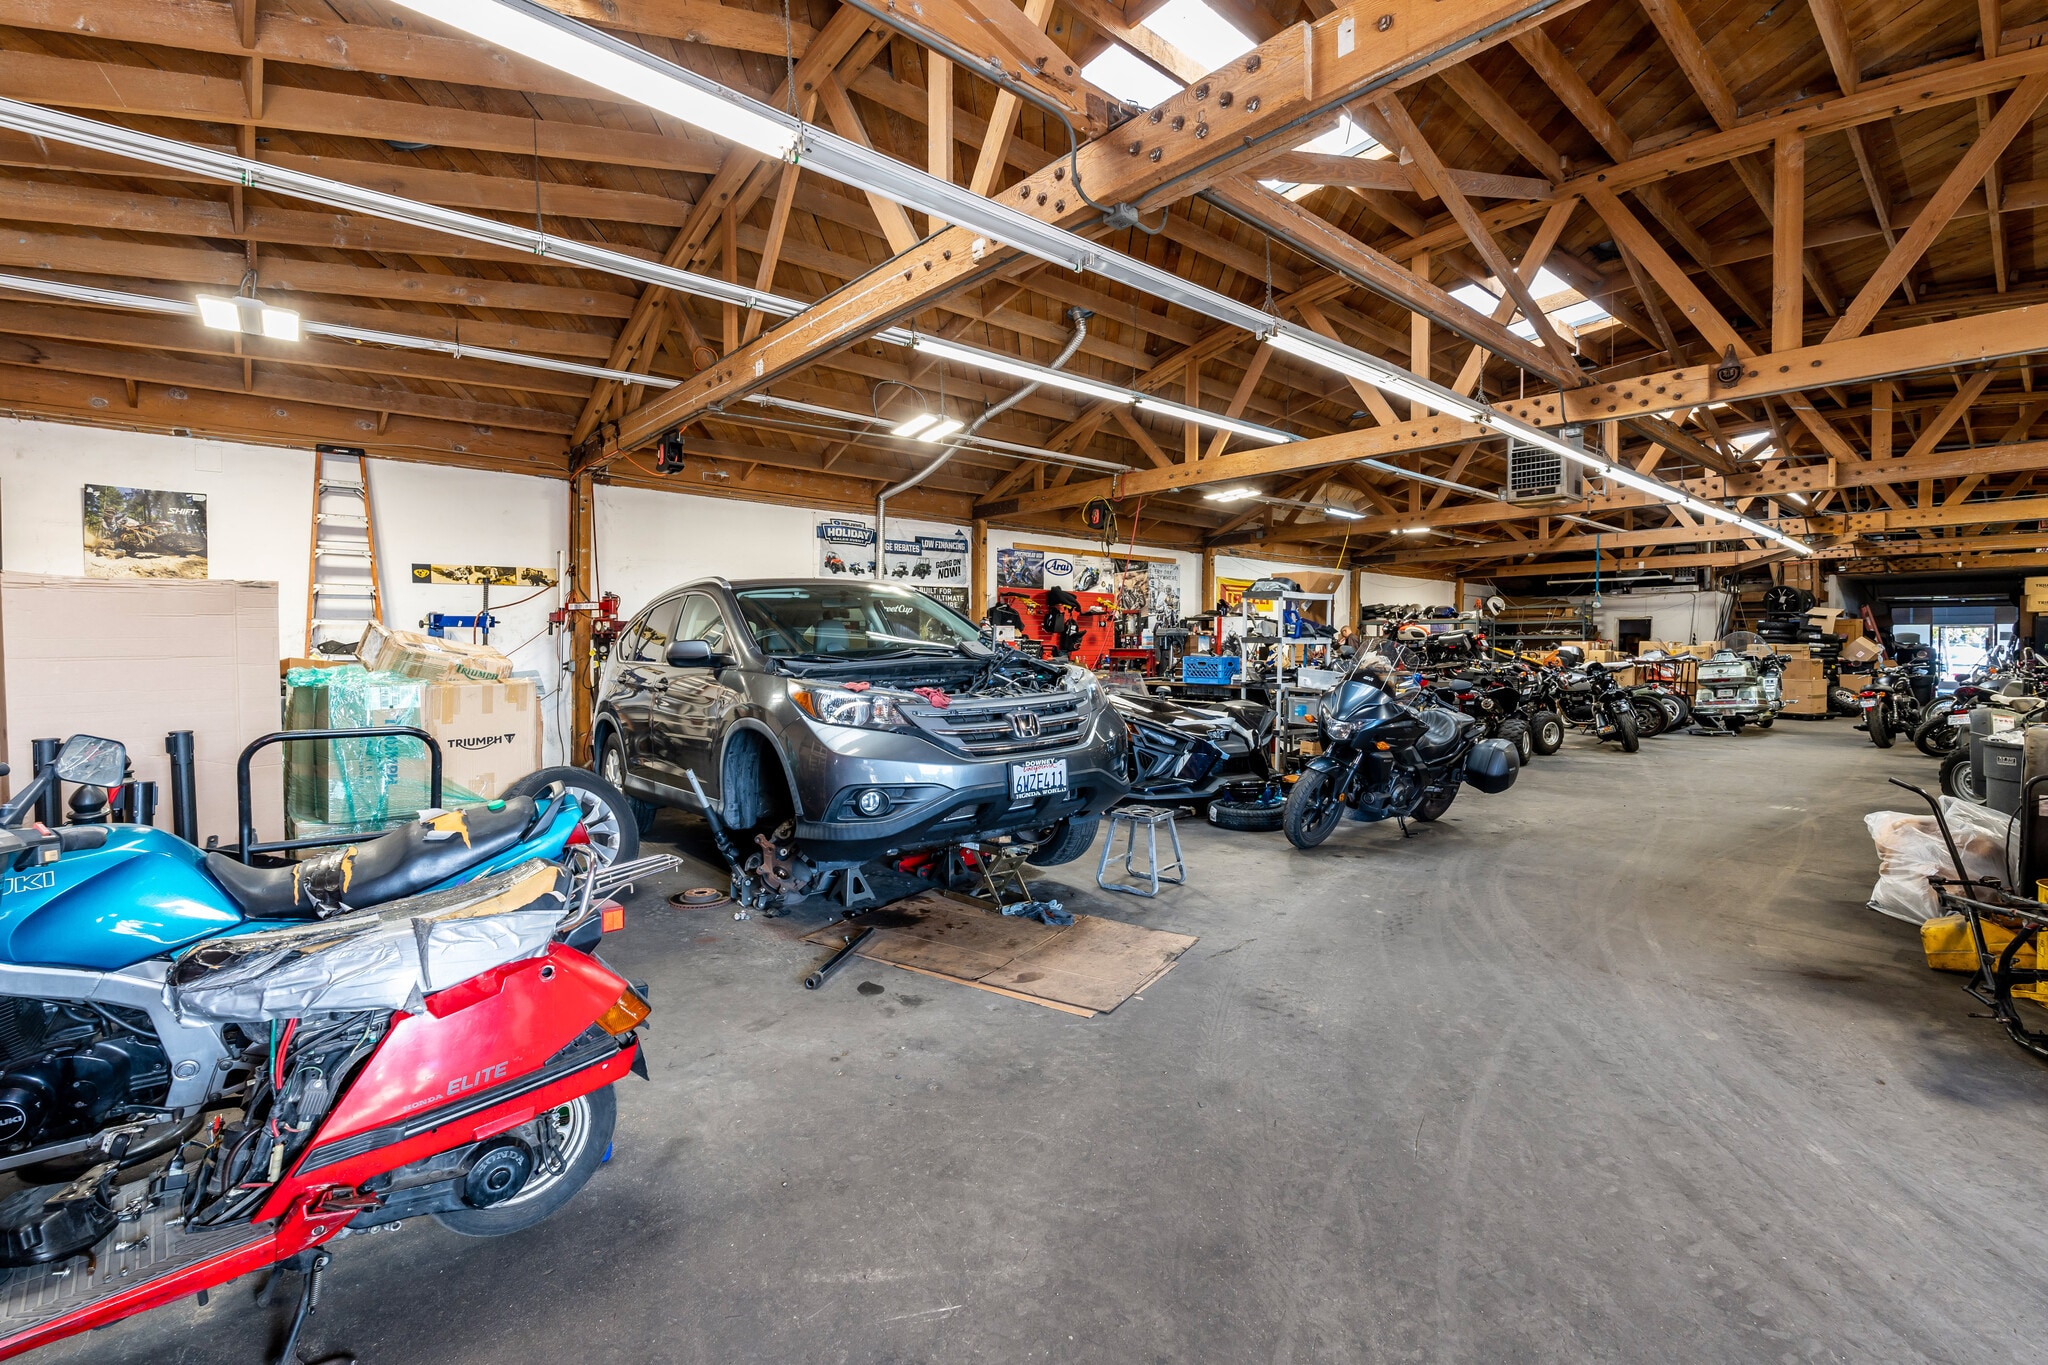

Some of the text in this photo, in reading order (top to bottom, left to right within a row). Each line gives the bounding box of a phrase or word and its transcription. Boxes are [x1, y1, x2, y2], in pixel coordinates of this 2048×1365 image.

[167, 507, 199, 515] SHIFT
[827, 527, 870, 540] HOLIDAY
[894, 542, 920, 553] REBATES
[921, 539, 966, 551] LOW FINANCING
[936, 558, 962, 569] GOING ON
[1048, 560, 1071, 571] Arai
[937, 566, 961, 580] NOW!
[456, 663, 499, 680] TRIUMPH
[447, 735, 502, 750] TRIUMPH
[1025, 757, 1055, 767] DOWNEY
[1015, 787, 1067, 799] HONDA WORLD
[402, 1060, 508, 1112] HONDA ELITE
[477, 1150, 525, 1175] HONDA
